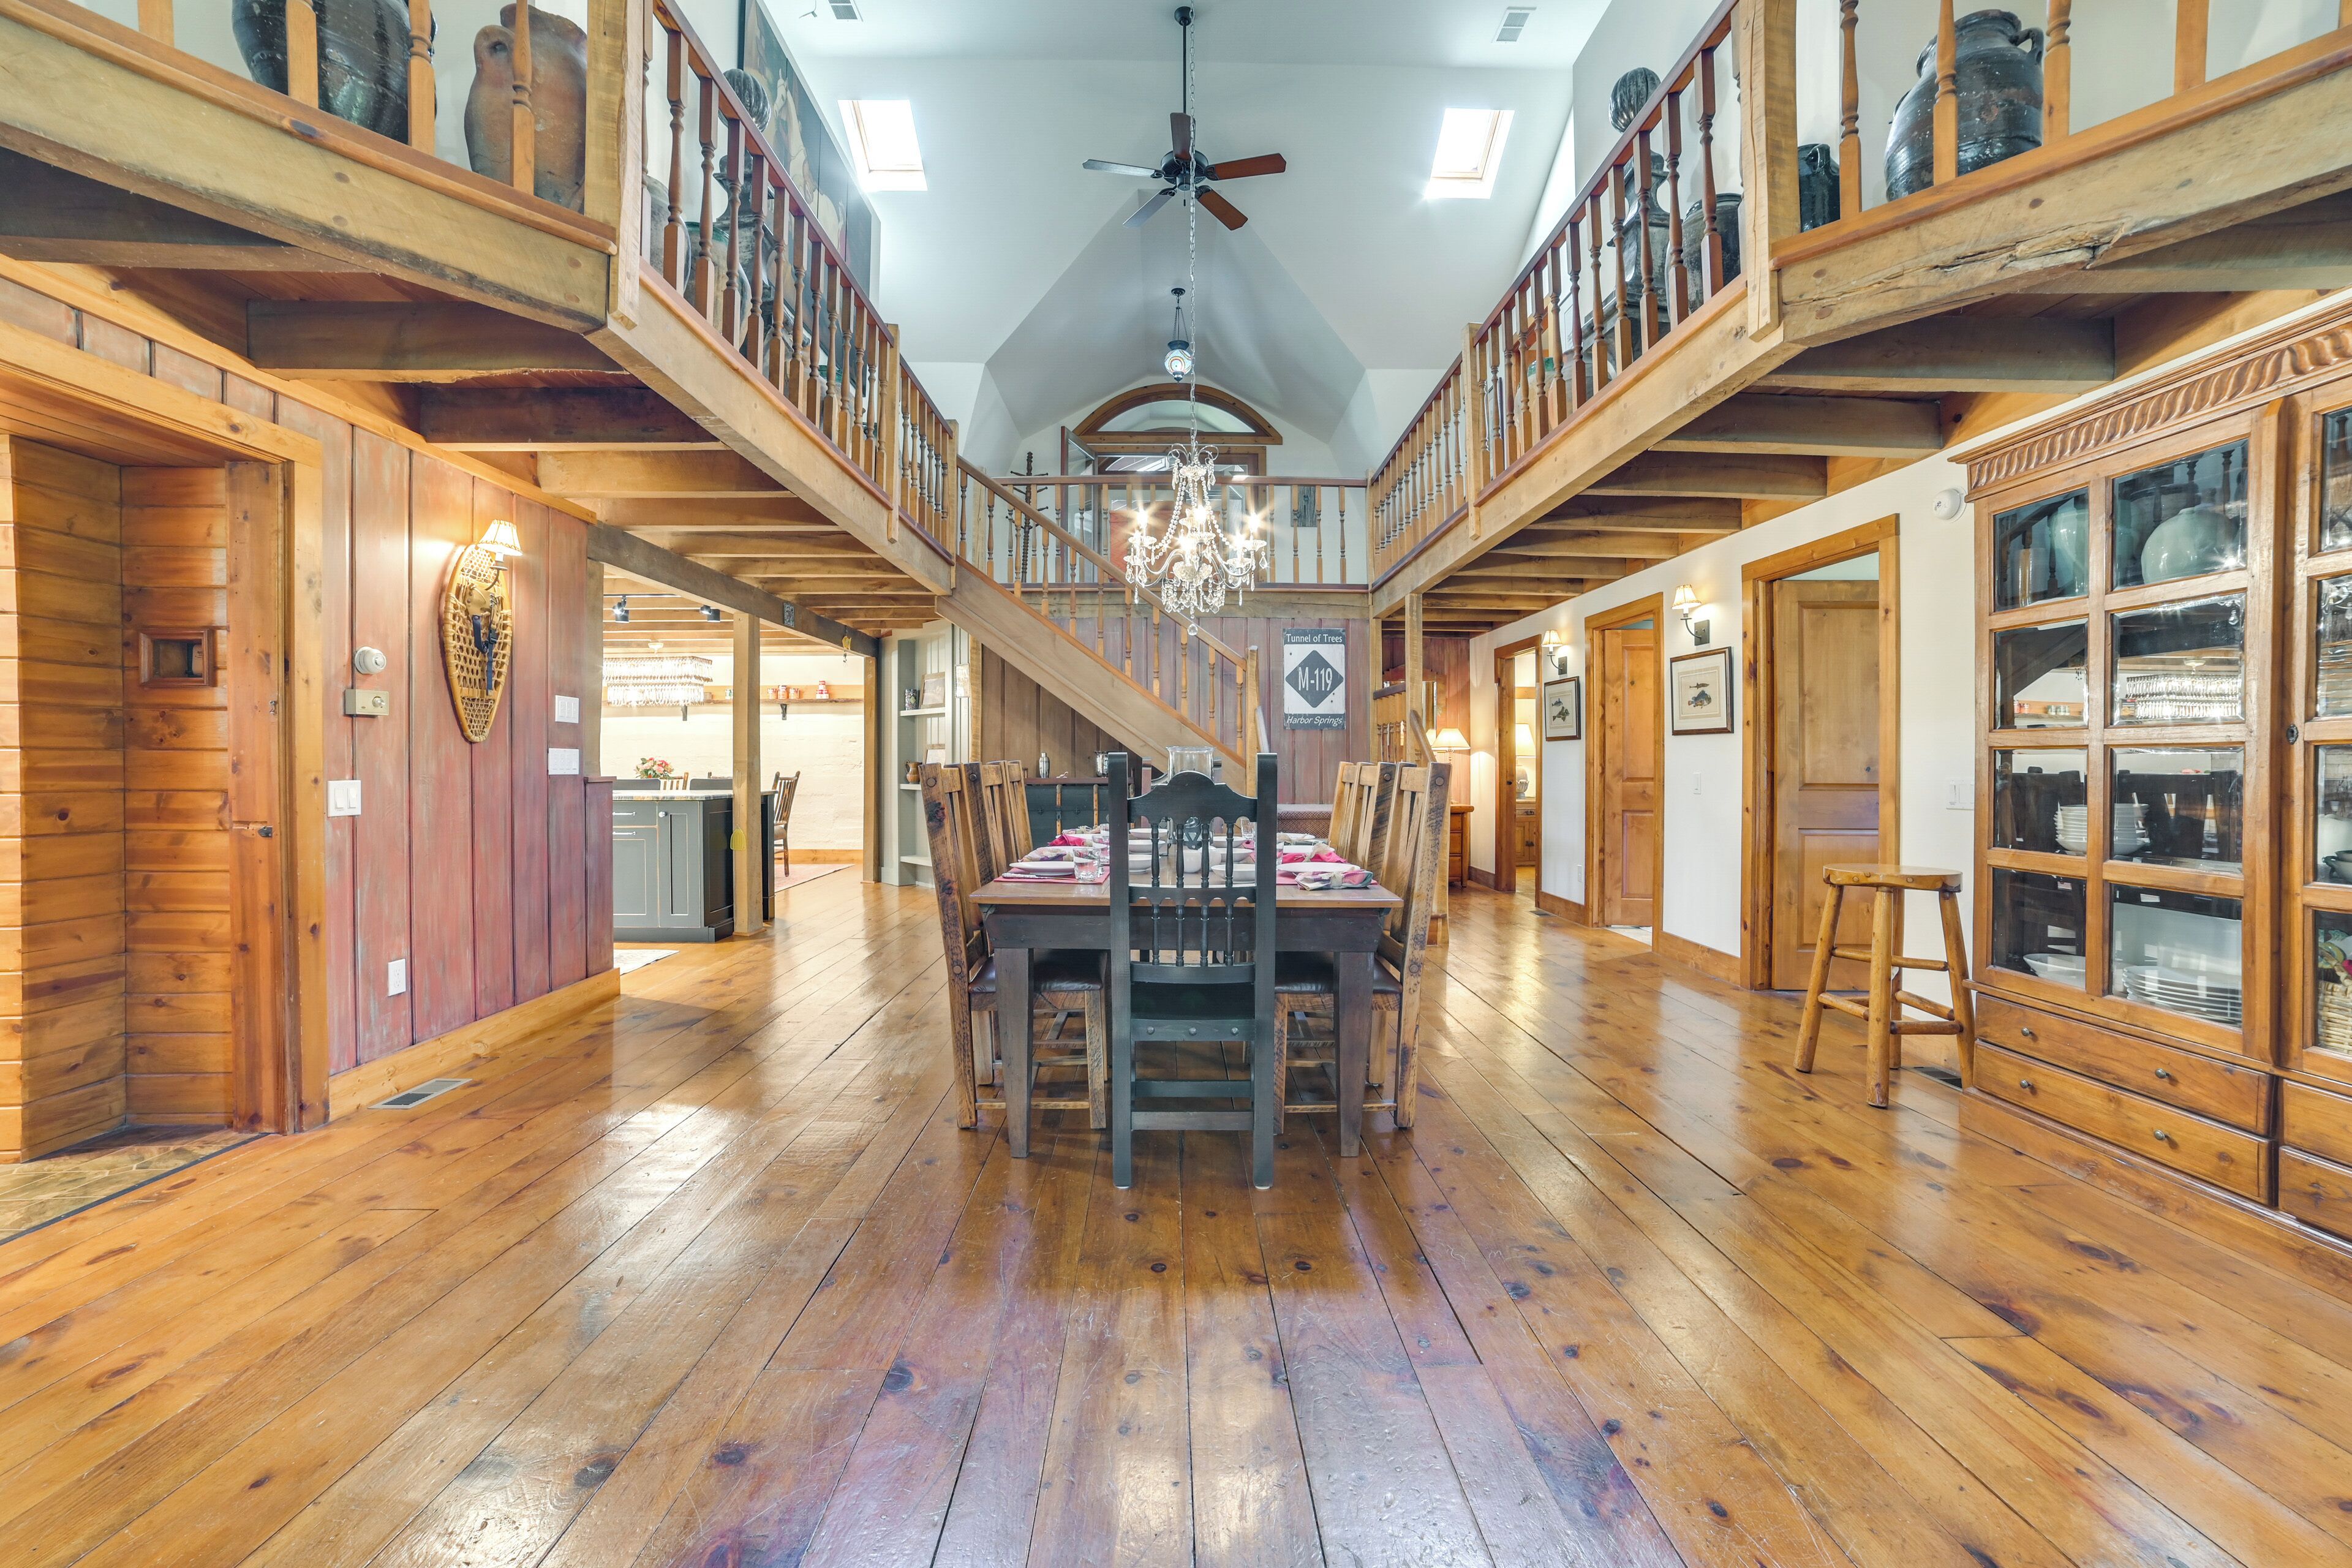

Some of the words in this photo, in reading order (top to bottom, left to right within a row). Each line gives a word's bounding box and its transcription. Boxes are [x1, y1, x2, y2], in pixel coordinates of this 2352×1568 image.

[1286, 633, 1311, 643] Tunnel
[1313, 634, 1321, 643] of
[1323, 634, 1343, 643] Trees
[1298, 666, 1333, 691] M-119
[1286, 715, 1313, 724] Harbor
[1314, 715, 1343, 726] Springs
